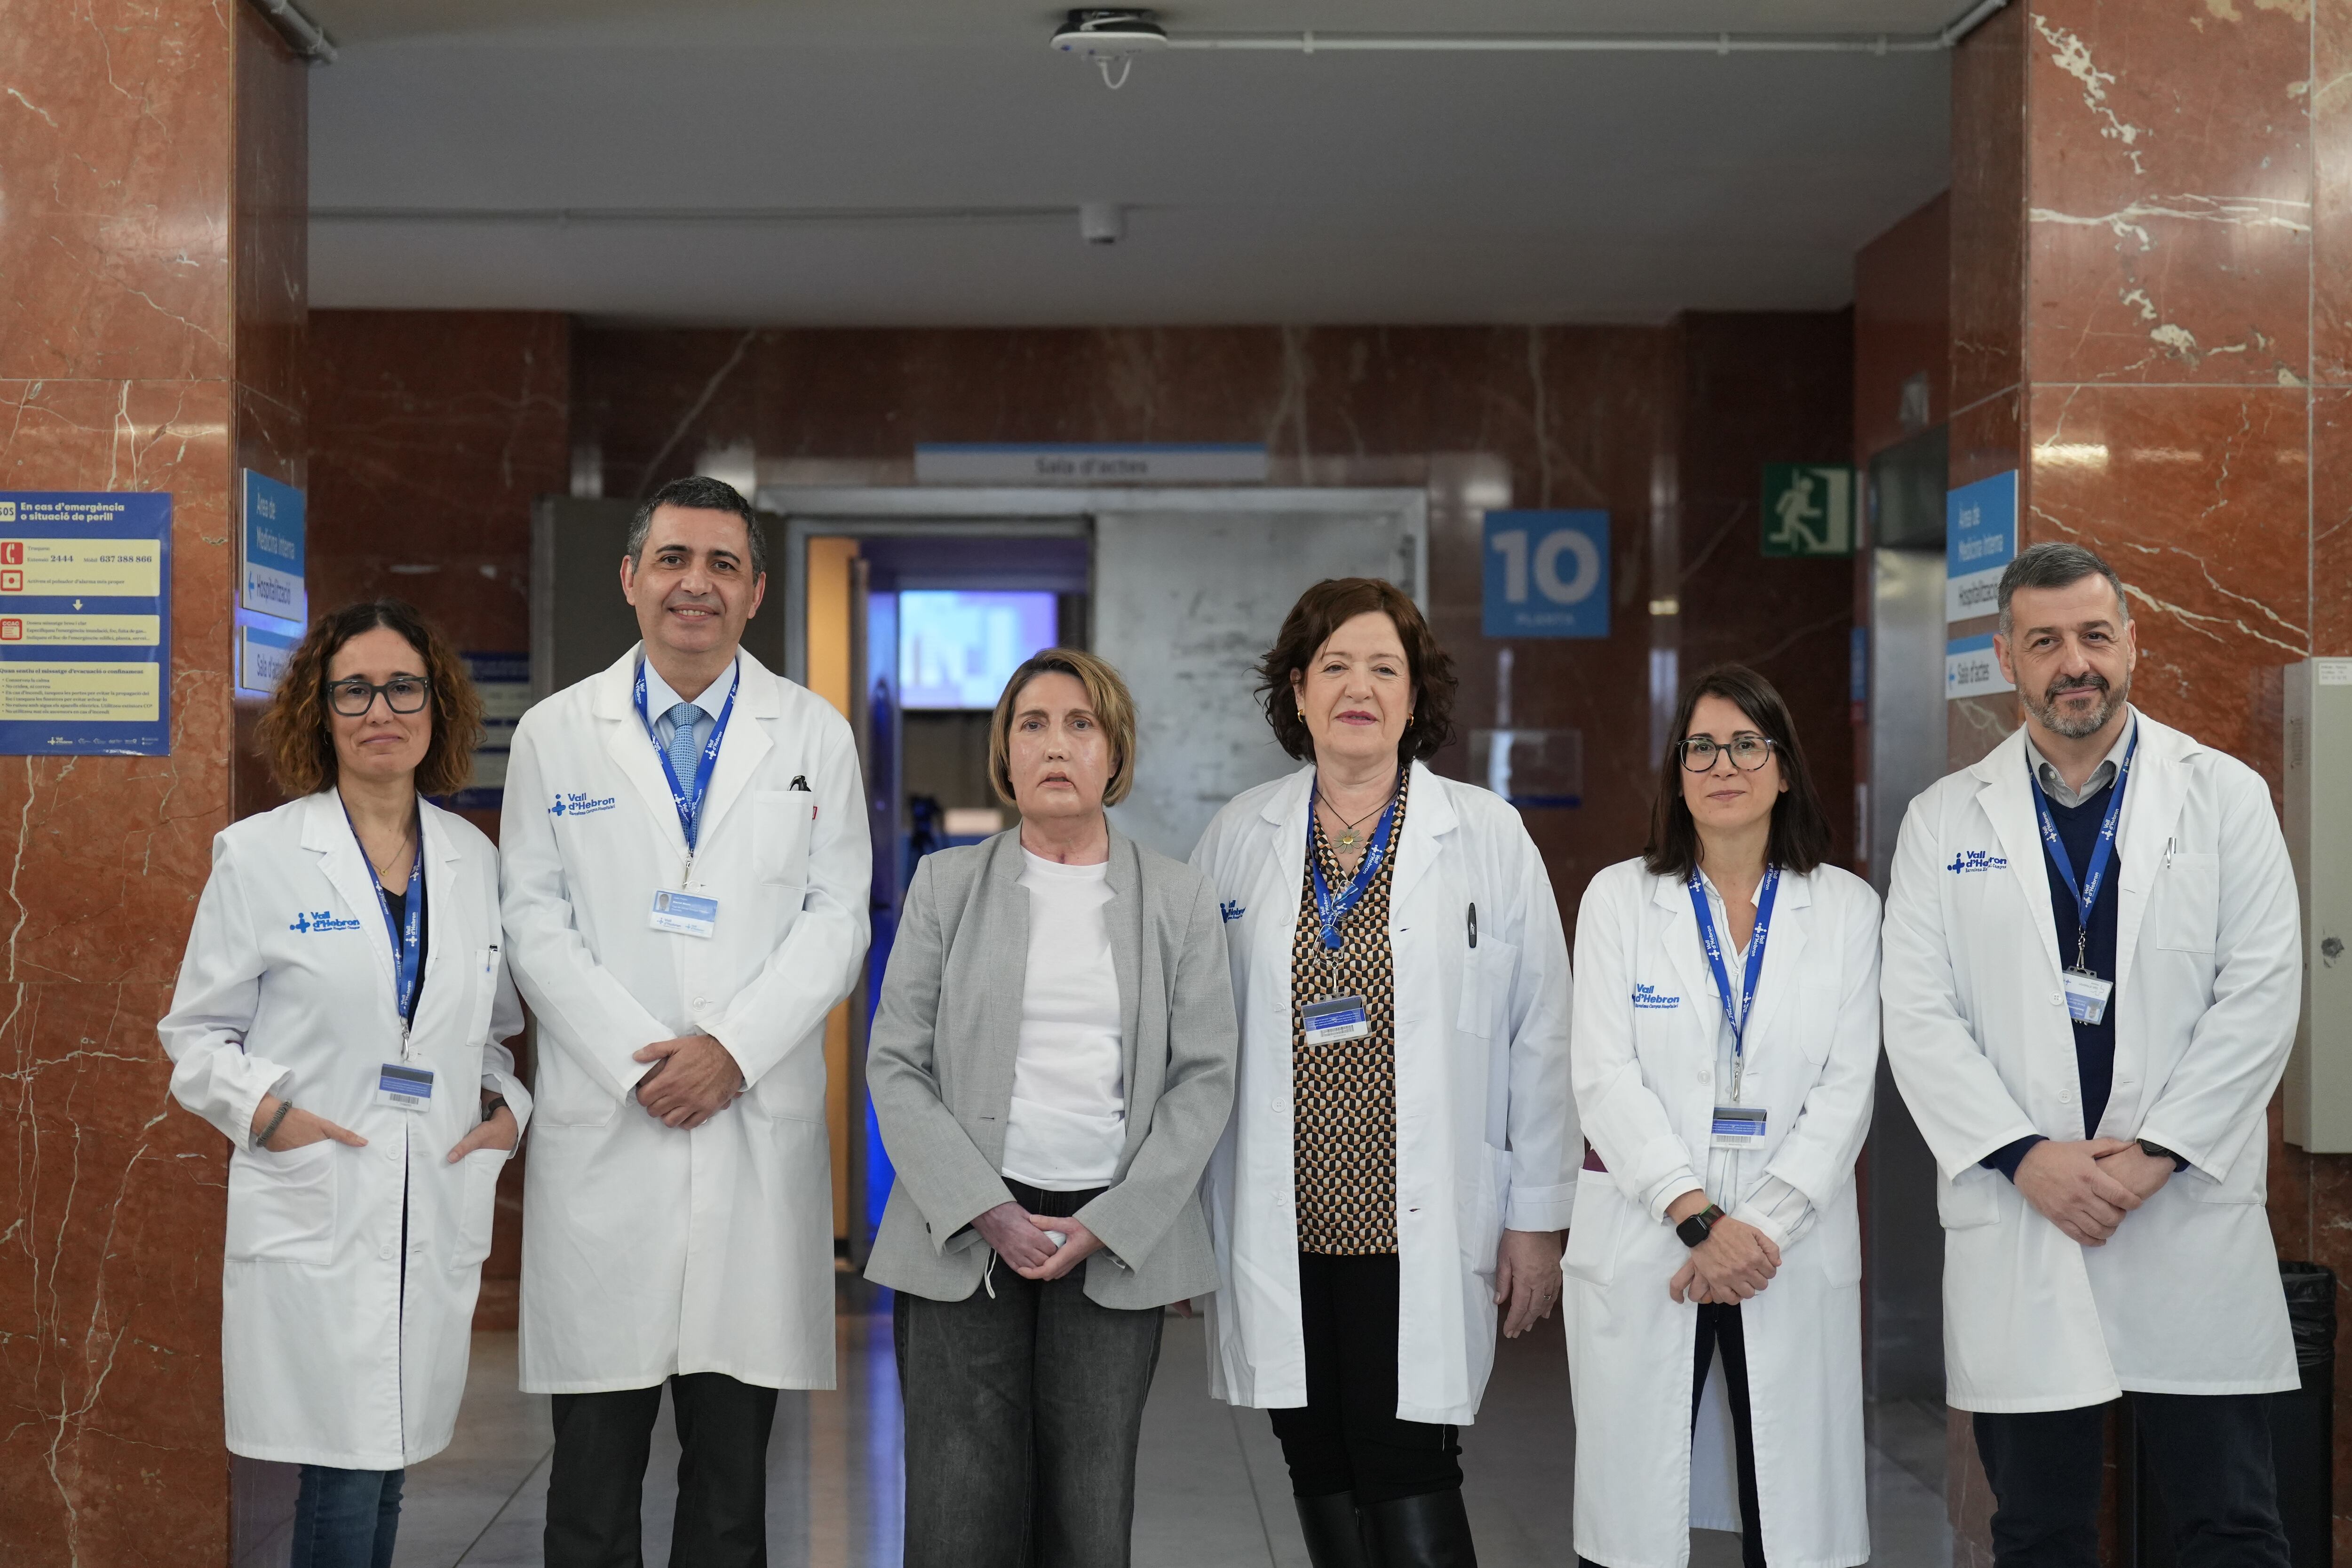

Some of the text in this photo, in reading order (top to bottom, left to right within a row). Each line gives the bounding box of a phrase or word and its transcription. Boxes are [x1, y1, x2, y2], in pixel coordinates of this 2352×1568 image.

[1036, 457, 1075, 474] Sala
[21, 502, 32, 511] En
[29, 511, 70, 521] situació
[72, 512, 85, 521] de
[86, 512, 113, 523] perill
[1492, 529, 1600, 605] 10
[712, 731, 723, 751] d'Hebron
[567, 793, 587, 802] Vall
[568, 797, 615, 811] d'Hebron
[2042, 811, 2053, 833] d'Hebron
[2108, 808, 2120, 830] d'Hebron
[1362, 852, 1376, 874] d'Hebron
[1967, 851, 1986, 859] Vall
[1765, 868, 1773, 891] d'Hebron
[2088, 871, 2099, 897] d'Hebron
[310, 911, 330, 920] Vall
[313, 919, 360, 928] d'Hebron
[1707, 925, 1716, 949] d'Hebron
[1751, 933, 1760, 957] d'Hebron
[1637, 983, 1654, 994] Vall
[1636, 994, 1680, 1003] d'Hebron
